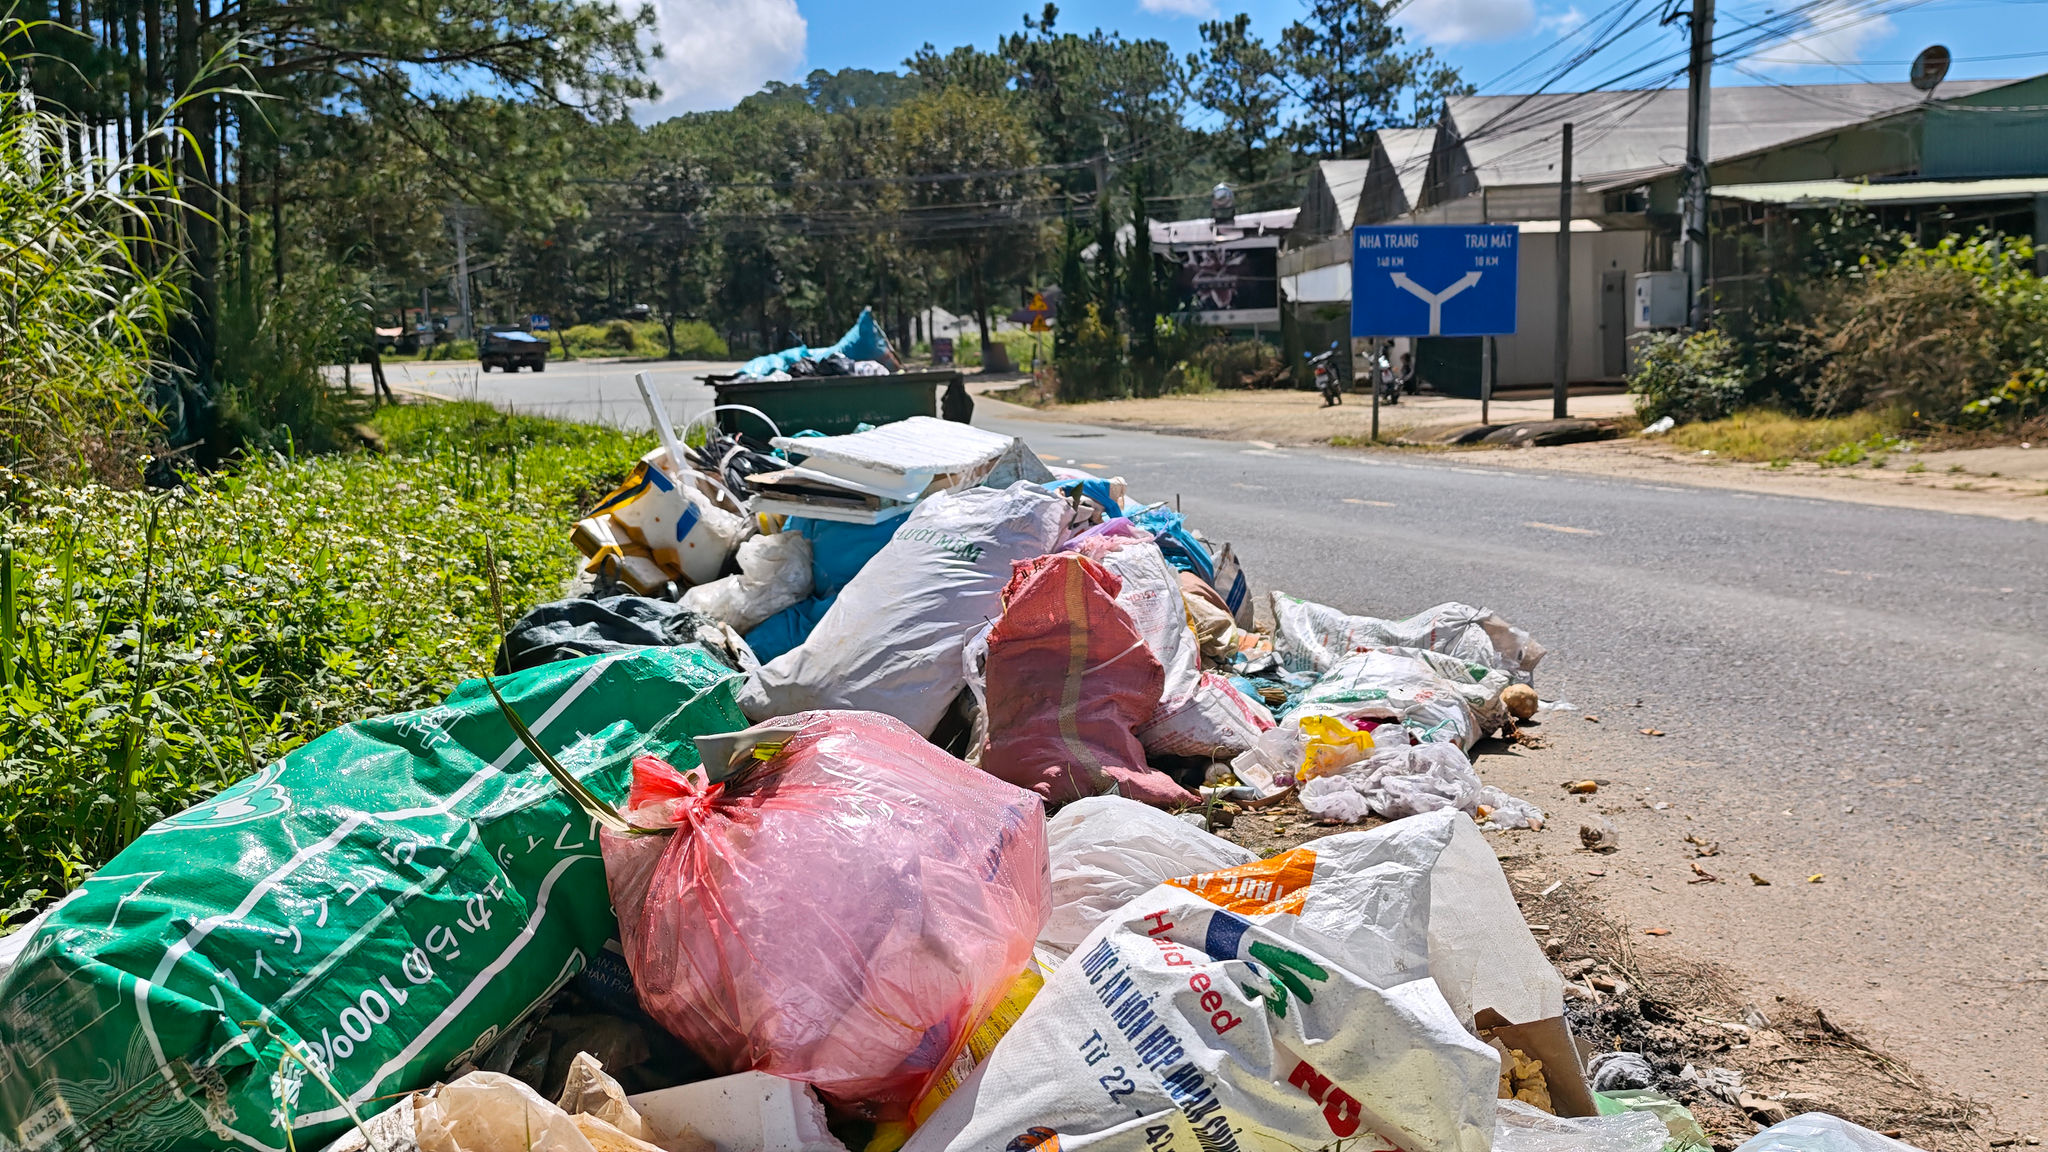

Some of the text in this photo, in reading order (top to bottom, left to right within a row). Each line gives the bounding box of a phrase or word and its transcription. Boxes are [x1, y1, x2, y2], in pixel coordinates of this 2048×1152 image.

[1359, 233, 1419, 248] NHA TRANG
[1391, 256, 1404, 267] KM
[1475, 256, 1499, 267] 10 KM
[1080, 936, 1120, 985] THỨC
[1096, 963, 1134, 1009] ĂN
[1111, 989, 1161, 1042] HỖN
[1079, 1028, 1111, 1067] Từ
[1099, 1065, 1136, 1105] 22
[1134, 1024, 1185, 1073] HỢP
[1161, 1061, 1222, 1123] HOÀN
